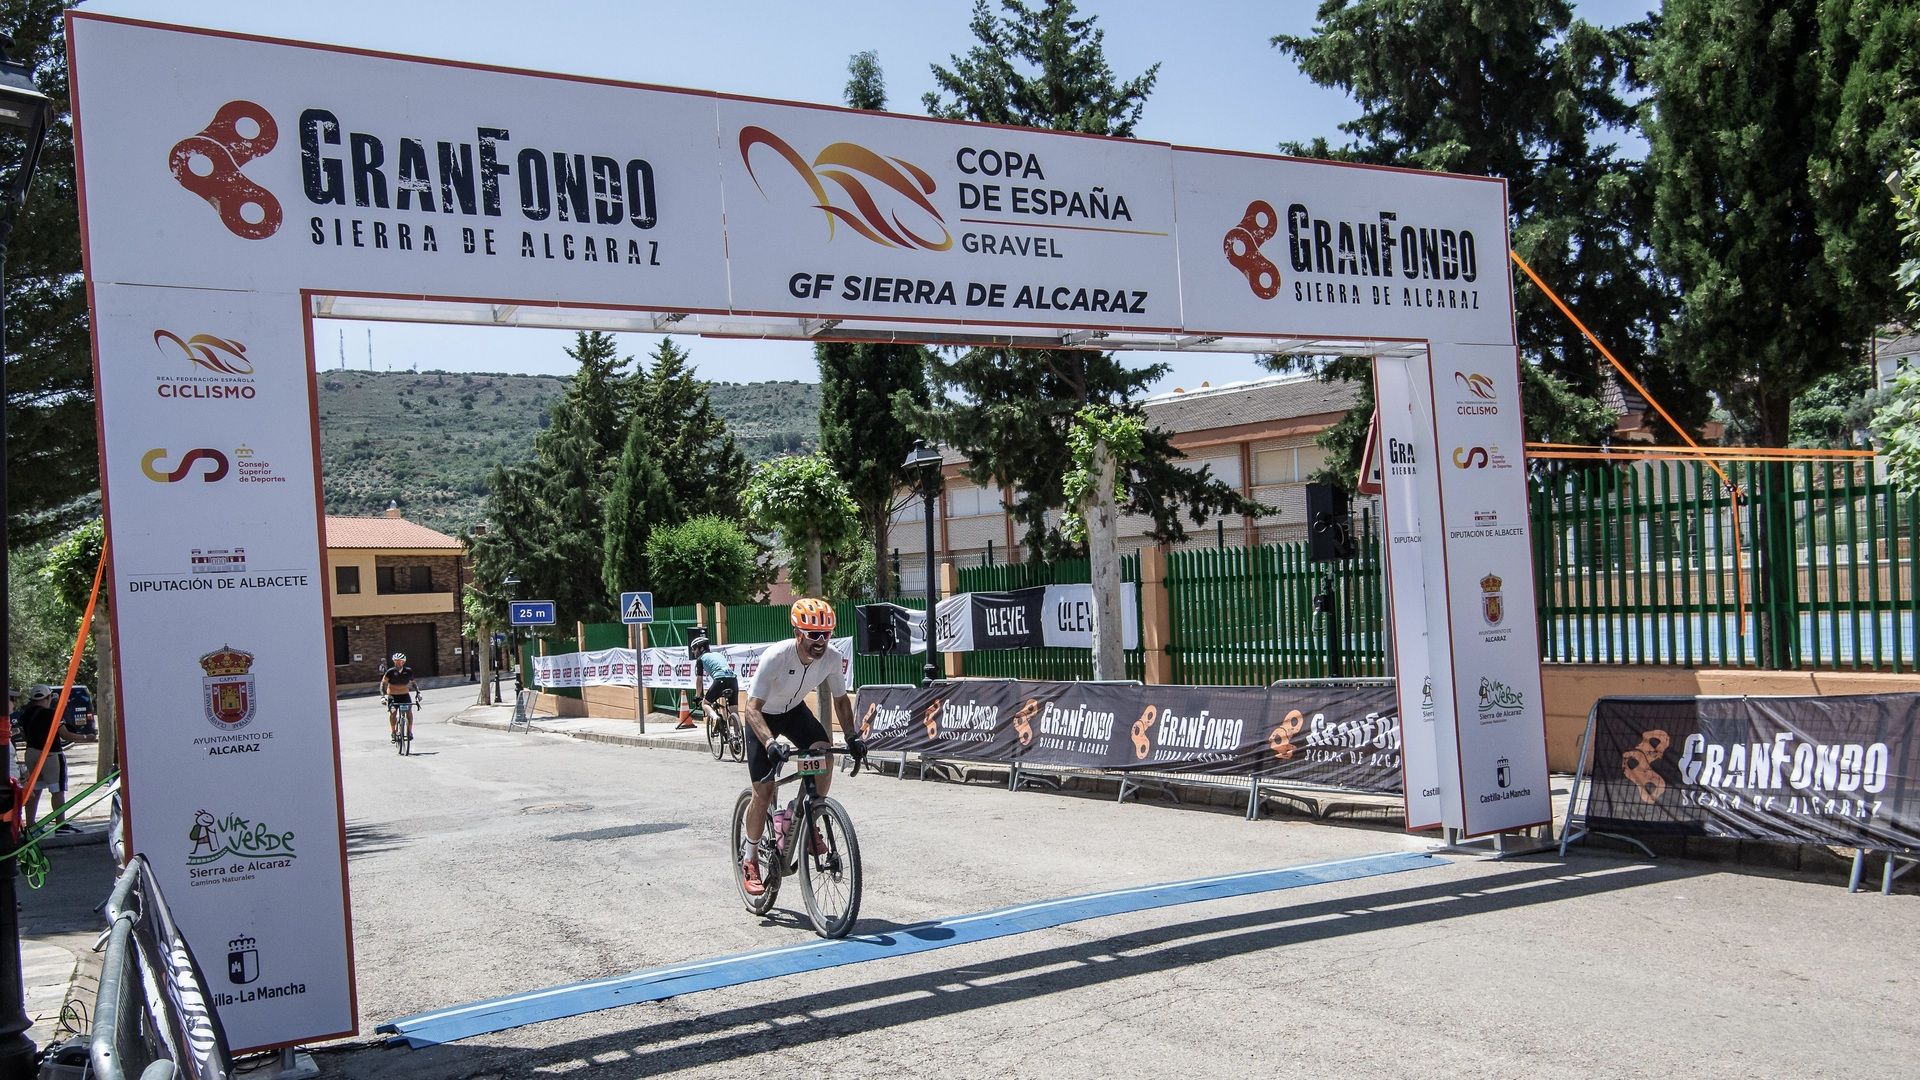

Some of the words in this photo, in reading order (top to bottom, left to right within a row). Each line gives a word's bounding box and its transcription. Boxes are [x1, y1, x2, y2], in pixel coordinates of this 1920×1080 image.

[956, 147, 1045, 180] COPA
[959, 182, 1003, 211] DE
[1012, 186, 1133, 222] ESPAÑA
[310, 216, 438, 252] SIERRA
[463, 228, 497, 256] DE
[521, 230, 661, 267] ALCARAZ
[962, 232, 1064, 259] GRAVEL
[788, 272, 834, 300] GF
[841, 275, 957, 306] SIERRA
[966, 283, 1006, 308] DE
[1013, 284, 1148, 314] ALCARAZ
[1294, 281, 1361, 305] SIERRA
[1372, 285, 1391, 306] DE
[1403, 287, 1479, 310] ALCARAZ
[157, 384, 256, 400] CICLISMO
[1457, 406, 1498, 415] CICLISMO
[238, 461, 269, 470] Consejo
[1495, 528, 1524, 537] ALBACETE
[129, 578, 213, 593] DIPUTACIÓN
[217, 579, 236, 589] DE
[239, 576, 308, 588] ALBACETE
[520, 609, 533, 618] 25
[536, 610, 546, 618] m
[1504, 709, 1522, 717] Alcaraz
[193, 733, 261, 745] AYUNTAMIENTO
[209, 743, 260, 755] ALCARAZ
[803, 760, 820, 771] 519
[1510, 788, 1531, 797] Mancha
[217, 812, 250, 832] VÍA
[190, 867, 226, 879] Sierra
[229, 864, 245, 874] de
[247, 859, 291, 871] Alcaraz
[190, 879, 220, 887] Caminos
[222, 874, 255, 883] Naturales
[257, 982, 306, 1000] Mancha
